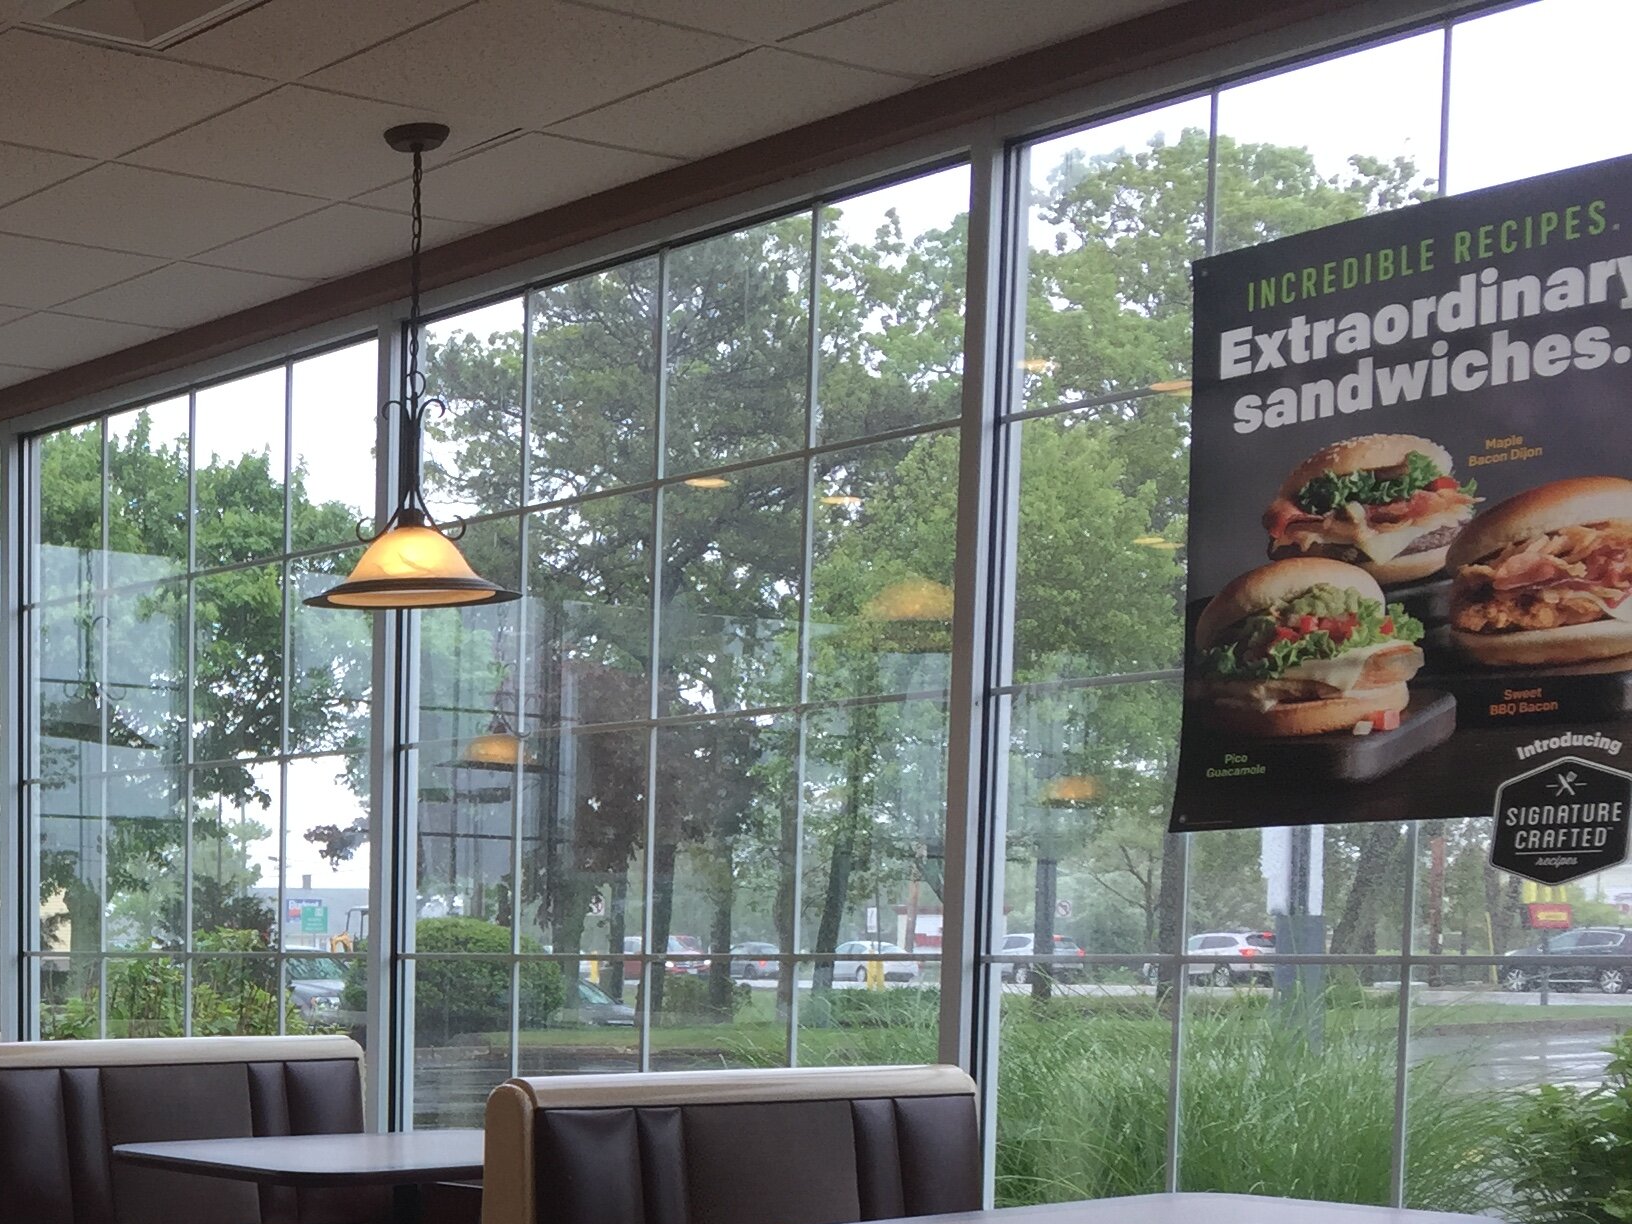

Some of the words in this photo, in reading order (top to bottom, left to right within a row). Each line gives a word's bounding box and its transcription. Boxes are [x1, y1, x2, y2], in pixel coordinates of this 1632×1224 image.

[1248, 239, 1435, 313] INCREDIBLE
[1233, 326, 1632, 434] sandwiches.
[1485, 434, 1524, 449] Maple
[1468, 453, 1508, 467] Bacon
[1510, 447, 1543, 461] Dijon
[1503, 688, 1542, 701] Sweet
[1489, 702, 1516, 716] BBQ
[1519, 701, 1558, 713] Bacon
[1516, 731, 1623, 760] Introducing
[1224, 753, 1248, 764] Pico
[1206, 764, 1266, 778] Guacamole
[1506, 801, 1623, 827] SIGNATURE
